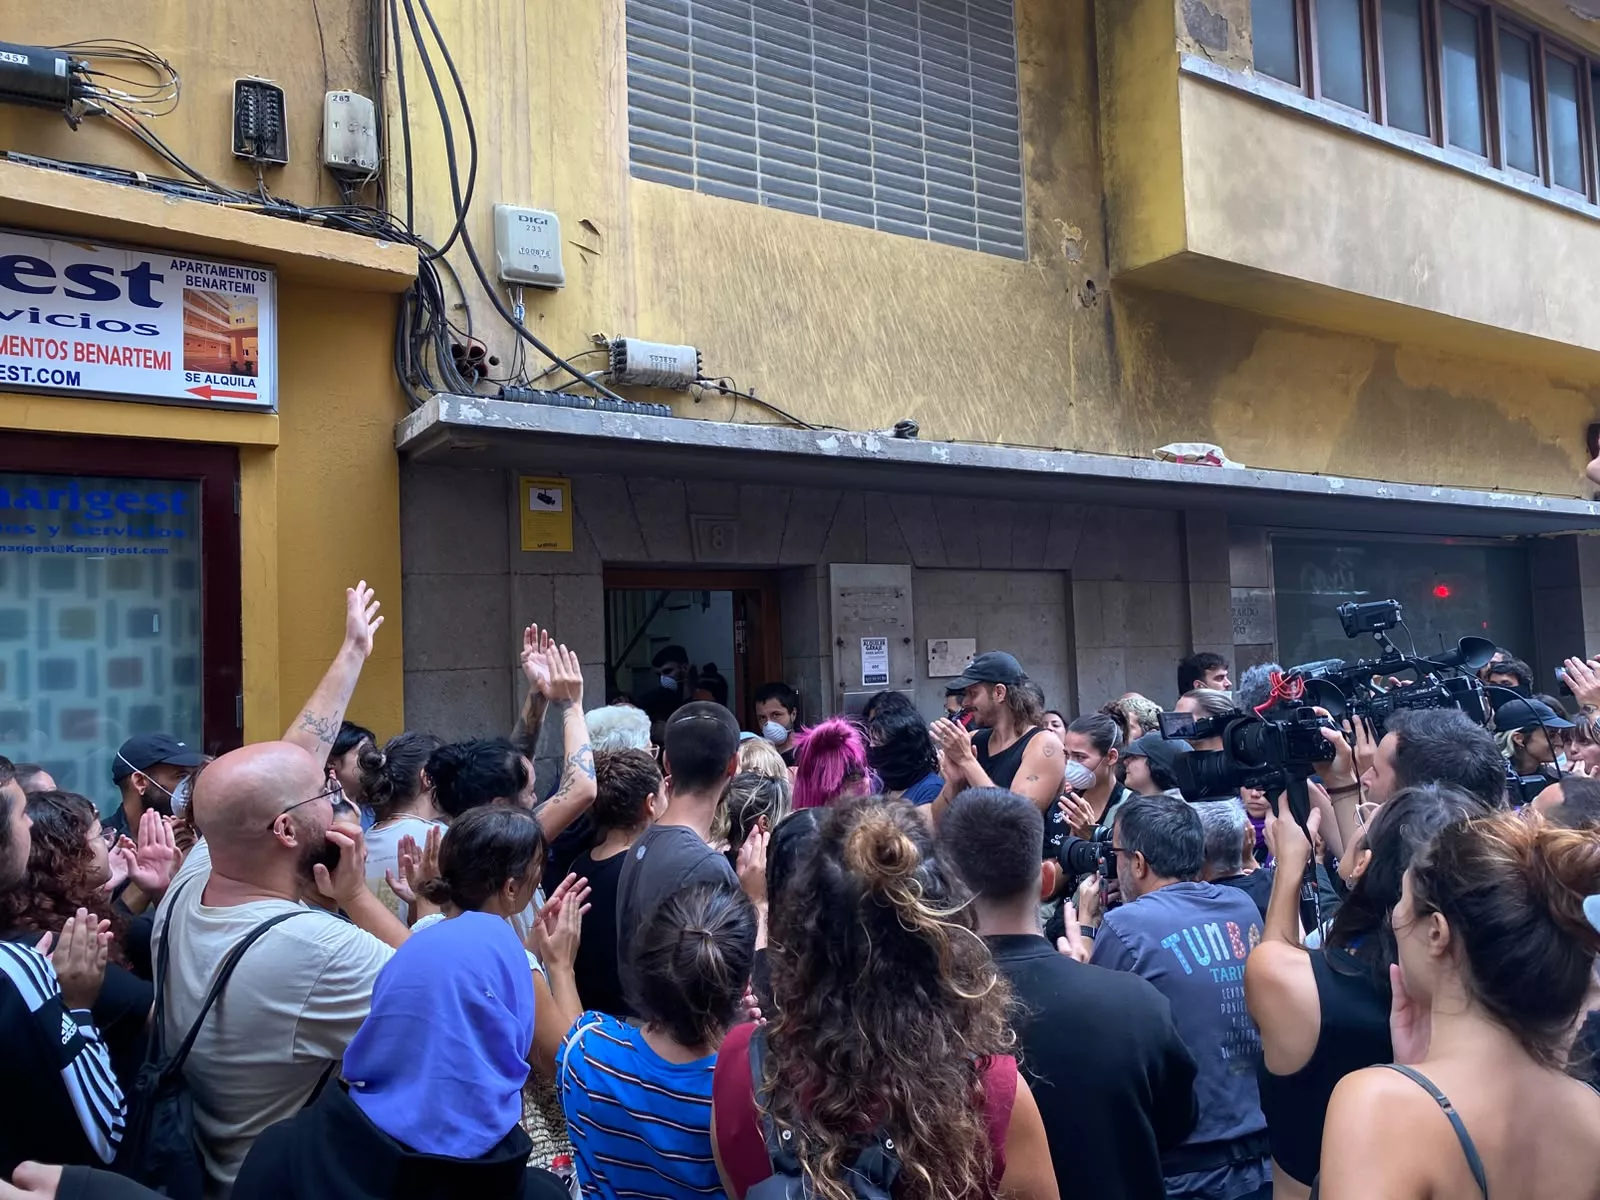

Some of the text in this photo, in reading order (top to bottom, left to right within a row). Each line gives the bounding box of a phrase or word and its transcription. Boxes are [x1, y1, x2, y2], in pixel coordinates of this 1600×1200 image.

[518, 214, 548, 226] DIGI
[526, 224, 542, 233] 233
[170, 259, 267, 283] APARTAMENTOS
[185, 274, 256, 294] BENARTEMI
[73, 341, 172, 371] BENARTEMI
[184, 372, 257, 389] SE ALQUILA
